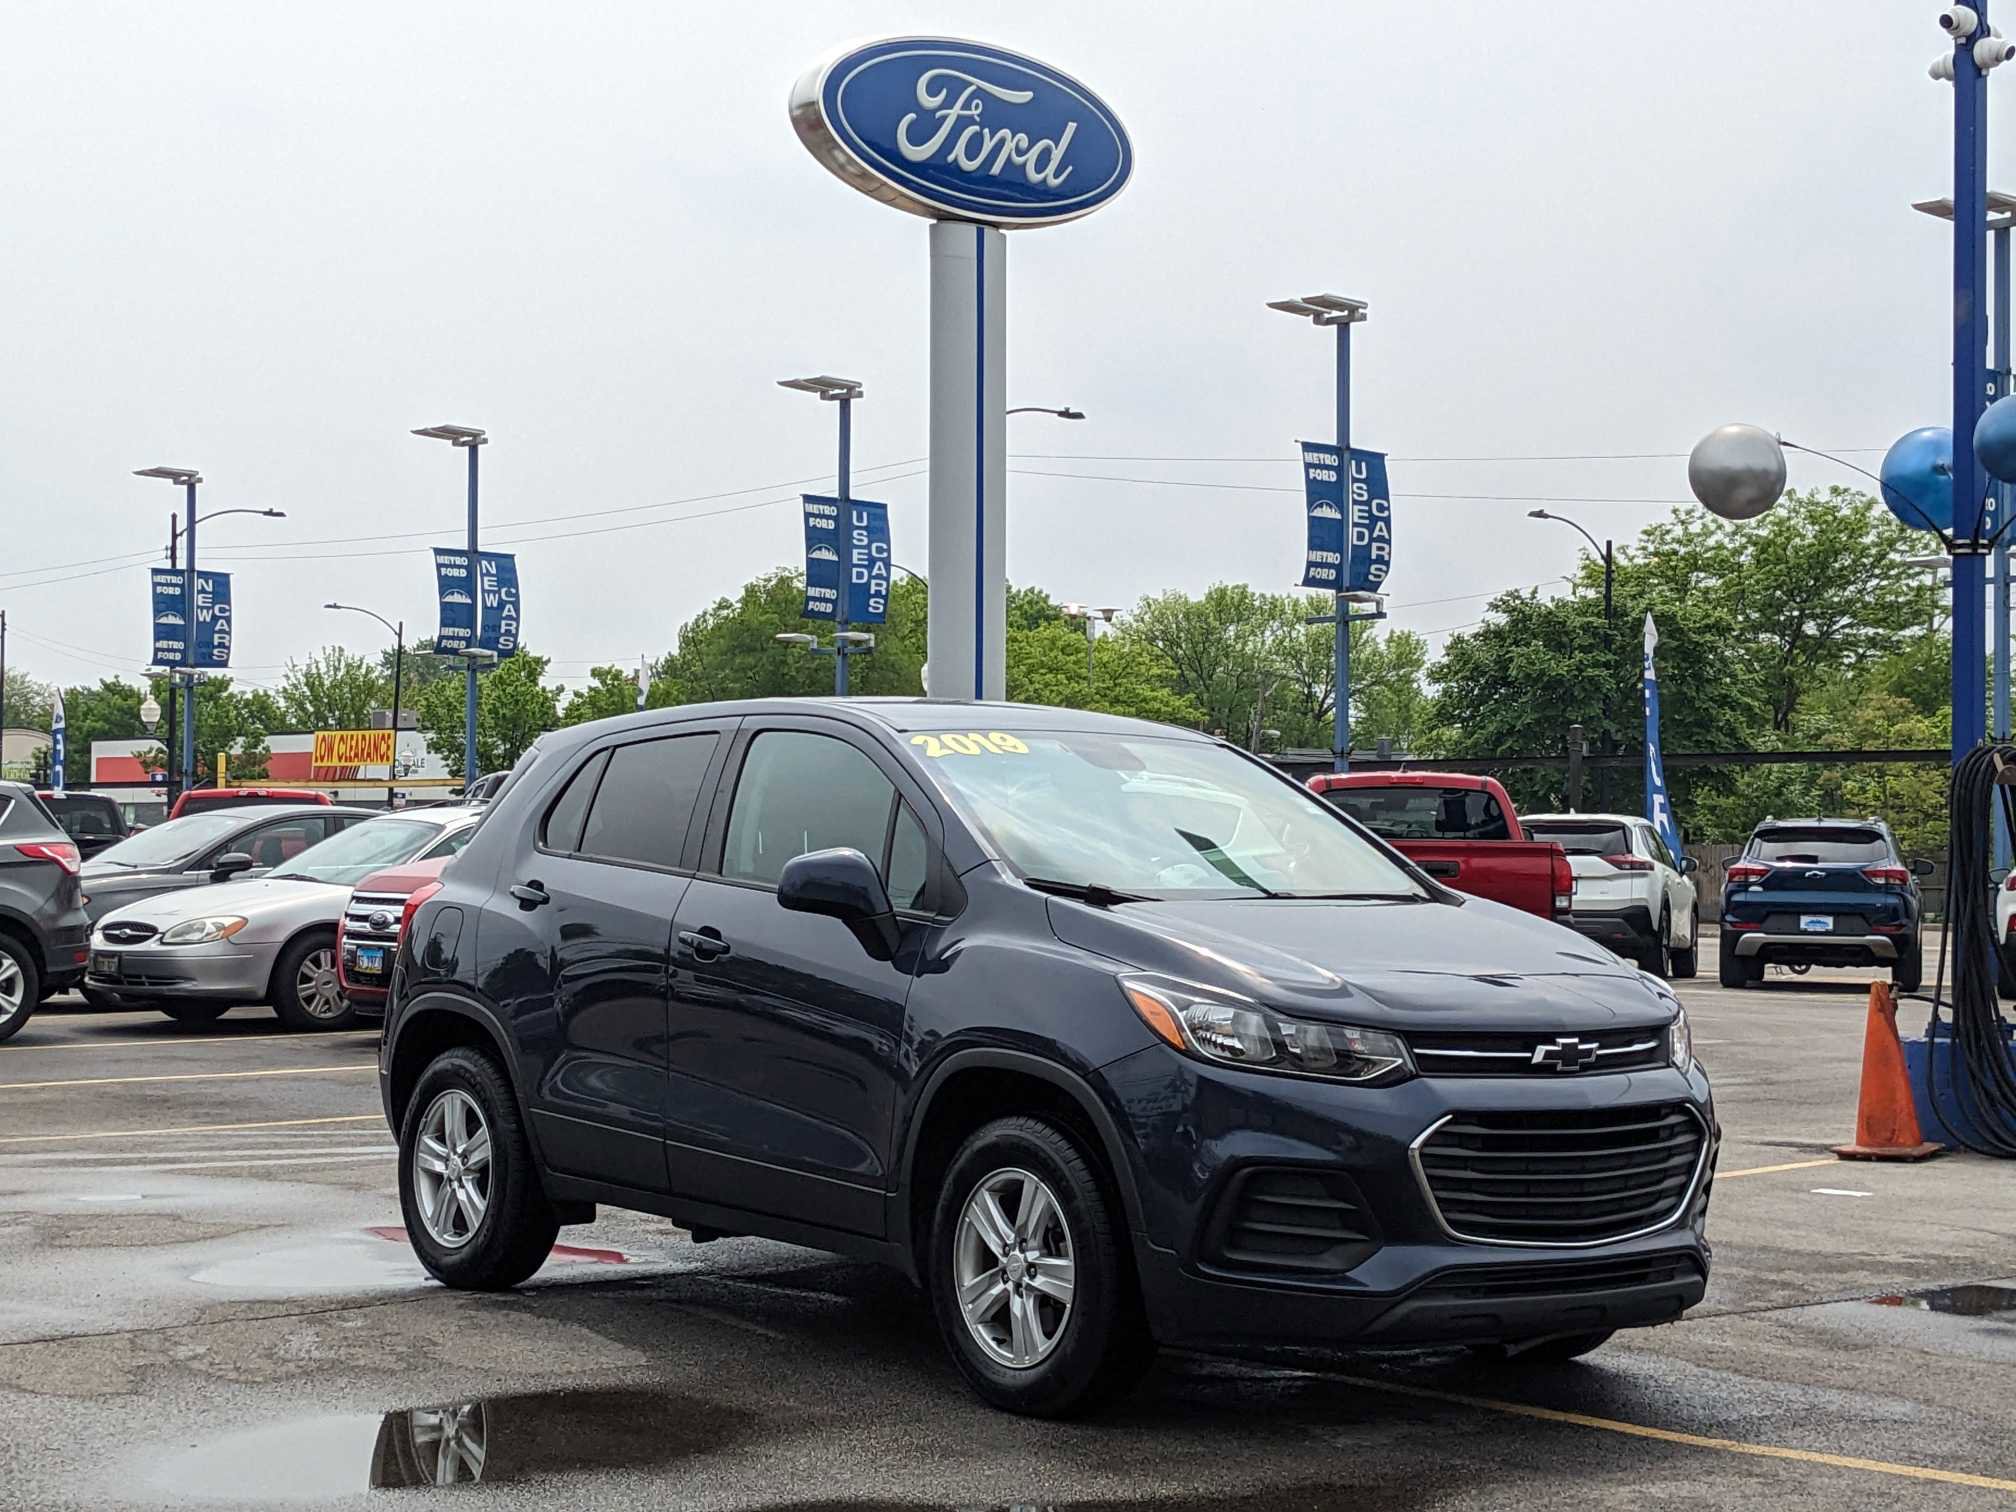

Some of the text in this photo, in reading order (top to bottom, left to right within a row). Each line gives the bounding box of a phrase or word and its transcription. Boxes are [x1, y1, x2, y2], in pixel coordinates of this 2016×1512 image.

[897, 68, 1078, 188] Ford
[1303, 451, 1339, 466] METRO
[1308, 468, 1337, 482] FORD
[804, 503, 838, 516] METRO
[1351, 460, 1370, 545] USED
[808, 517, 835, 530] FORD
[852, 510, 869, 584] USED
[1368, 499, 1390, 582] CARS
[436, 555, 468, 566] METRO
[1308, 550, 1341, 564] METRO
[440, 567, 468, 577] FORD
[867, 542, 888, 613] CARS
[1308, 567, 1337, 581] FORD
[152, 575, 184, 585] METRO
[481, 560, 499, 608] NEW
[156, 586, 181, 595] FORD
[807, 586, 838, 600] METRO
[197, 578, 213, 622] NEW
[807, 601, 833, 613] FORD
[498, 587, 517, 650] CARS
[212, 604, 231, 661] CARS
[440, 627, 472, 637] METRO
[155, 640, 185, 650] METRO
[441, 639, 467, 649] FORD
[157, 651, 182, 661] FORD
[314, 732, 391, 763] LOW CLEARANCE
[909, 731, 1030, 758] 2019
